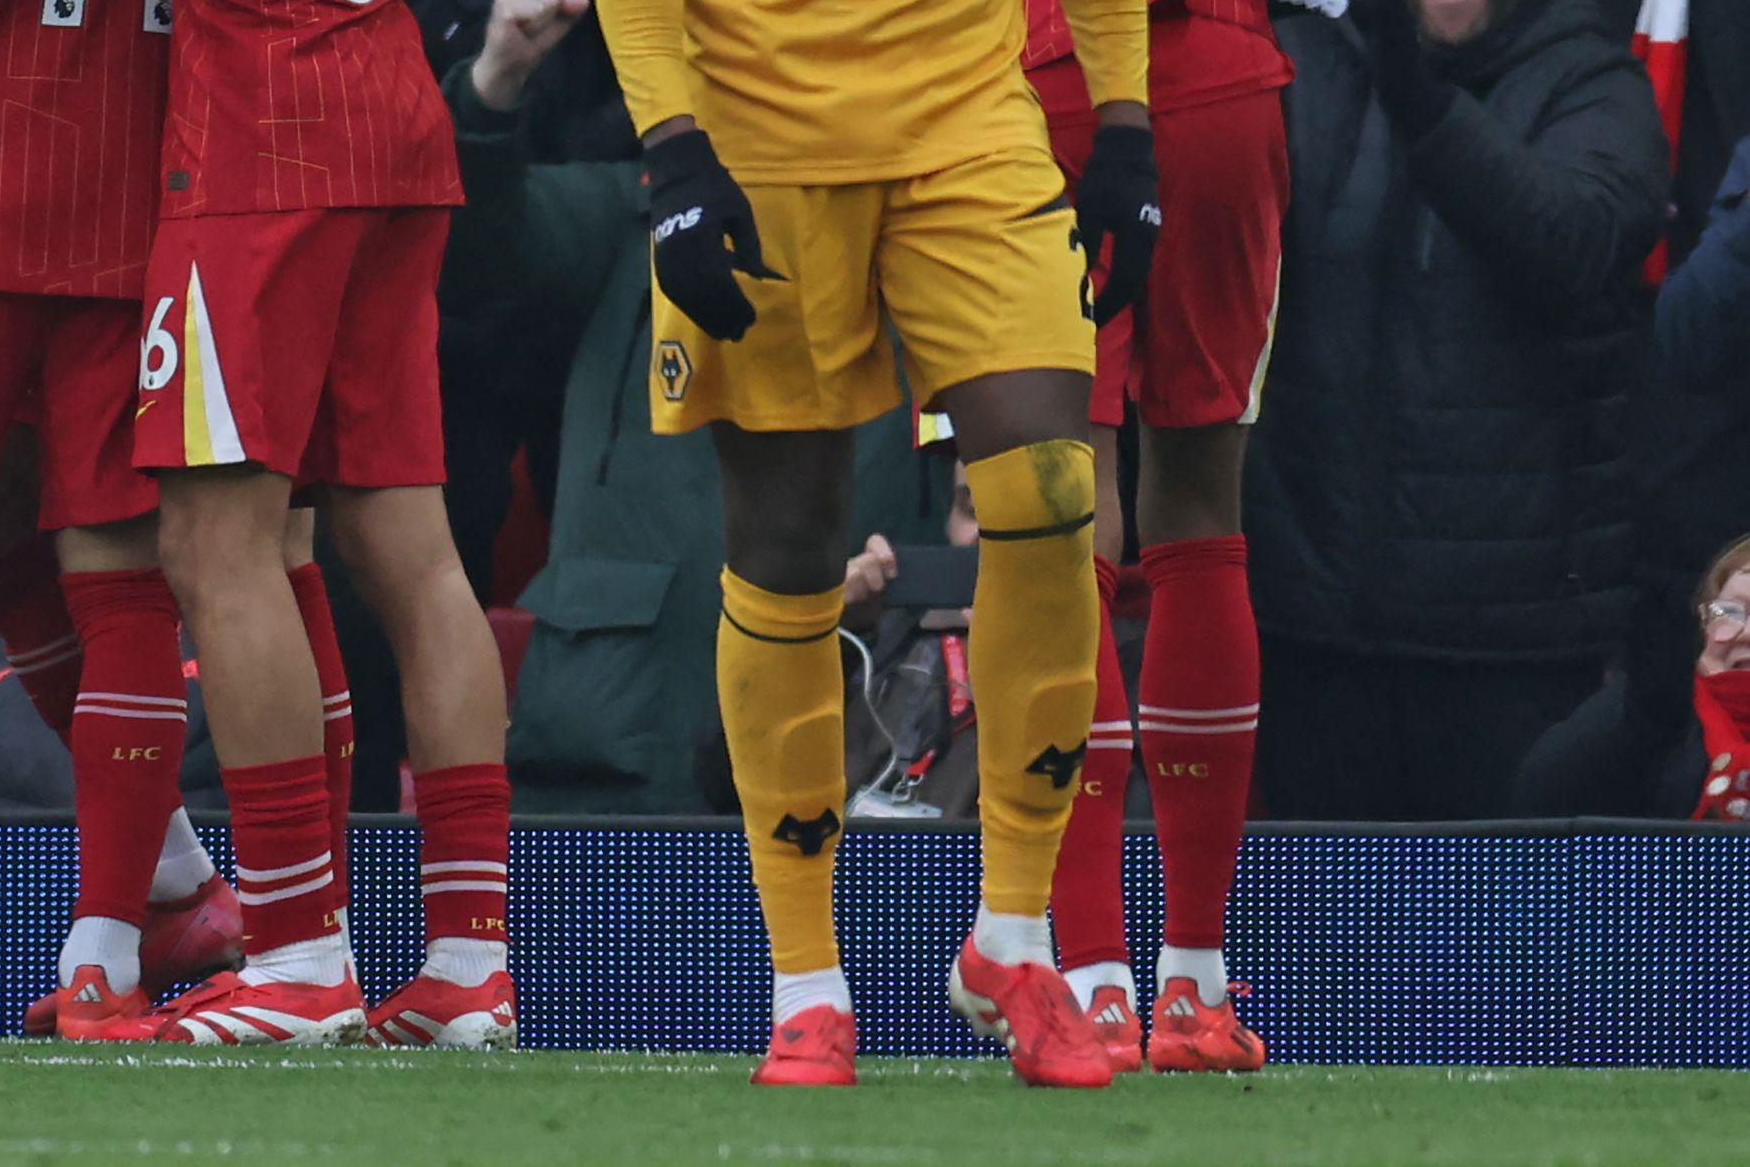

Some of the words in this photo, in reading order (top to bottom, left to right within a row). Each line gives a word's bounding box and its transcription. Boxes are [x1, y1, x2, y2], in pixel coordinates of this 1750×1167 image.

[138, 295, 179, 391] 6
[111, 746, 162, 762] LFC
[1157, 762, 1210, 778] LFC
